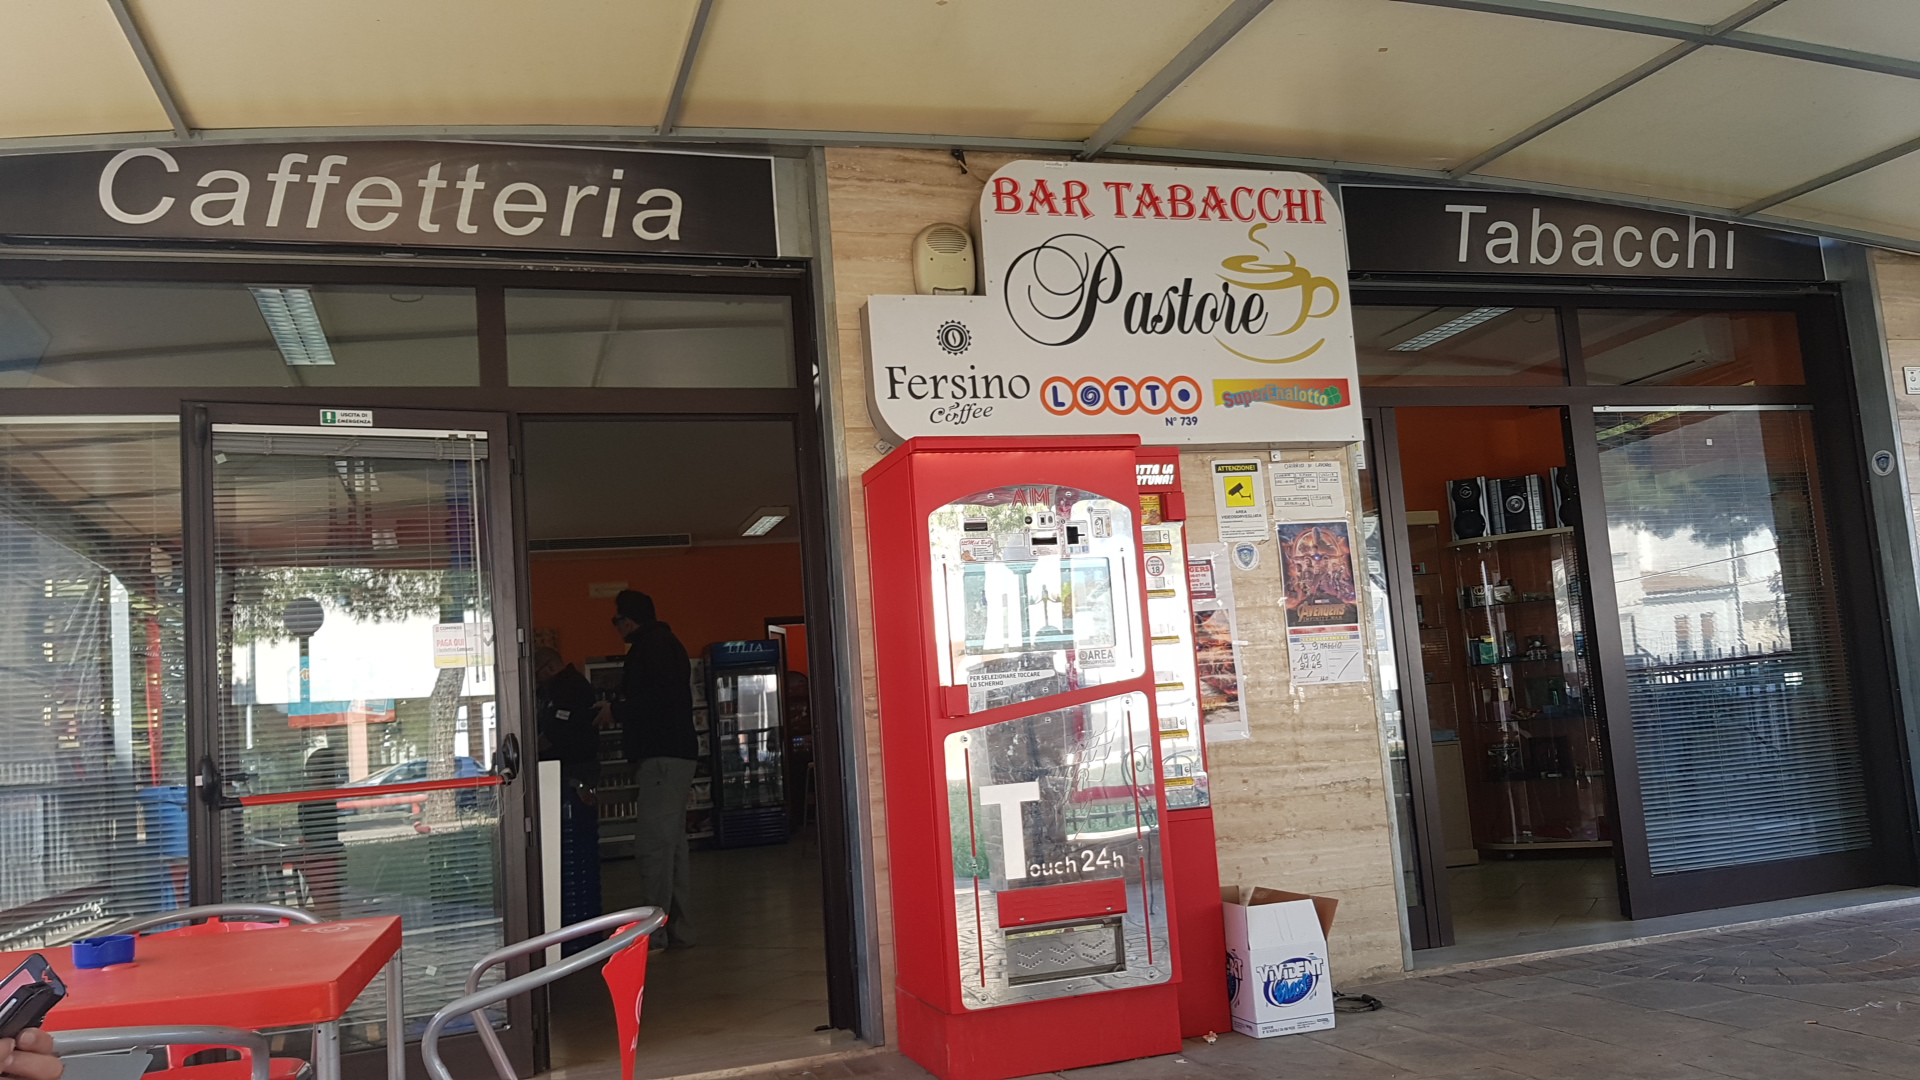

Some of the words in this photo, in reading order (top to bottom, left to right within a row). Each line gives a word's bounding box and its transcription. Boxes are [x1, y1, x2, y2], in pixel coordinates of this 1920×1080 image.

[98, 148, 684, 242] Caffetteria
[992, 177, 1095, 220] BAR
[1103, 181, 1327, 224] TABACCHI
[1445, 204, 1735, 270] Tabacchi
[1004, 233, 1269, 346] Pastore
[885, 364, 1031, 400] Fersino
[1040, 375, 1202, 416] LOTTO
[1222, 384, 1329, 409] SuperEnalotto
[930, 402, 993, 425] Coffee
[1180, 416, 1198, 426] 739
[1162, 464, 1174, 474] LA
[436, 639, 452, 647] PAGA
[454, 638, 465, 646] QUI
[728, 643, 764, 654] LILIA
[1088, 650, 1114, 660] AREA
[982, 672, 1017, 680] SELEZIONARE
[1080, 848, 1124, 872] 24h
